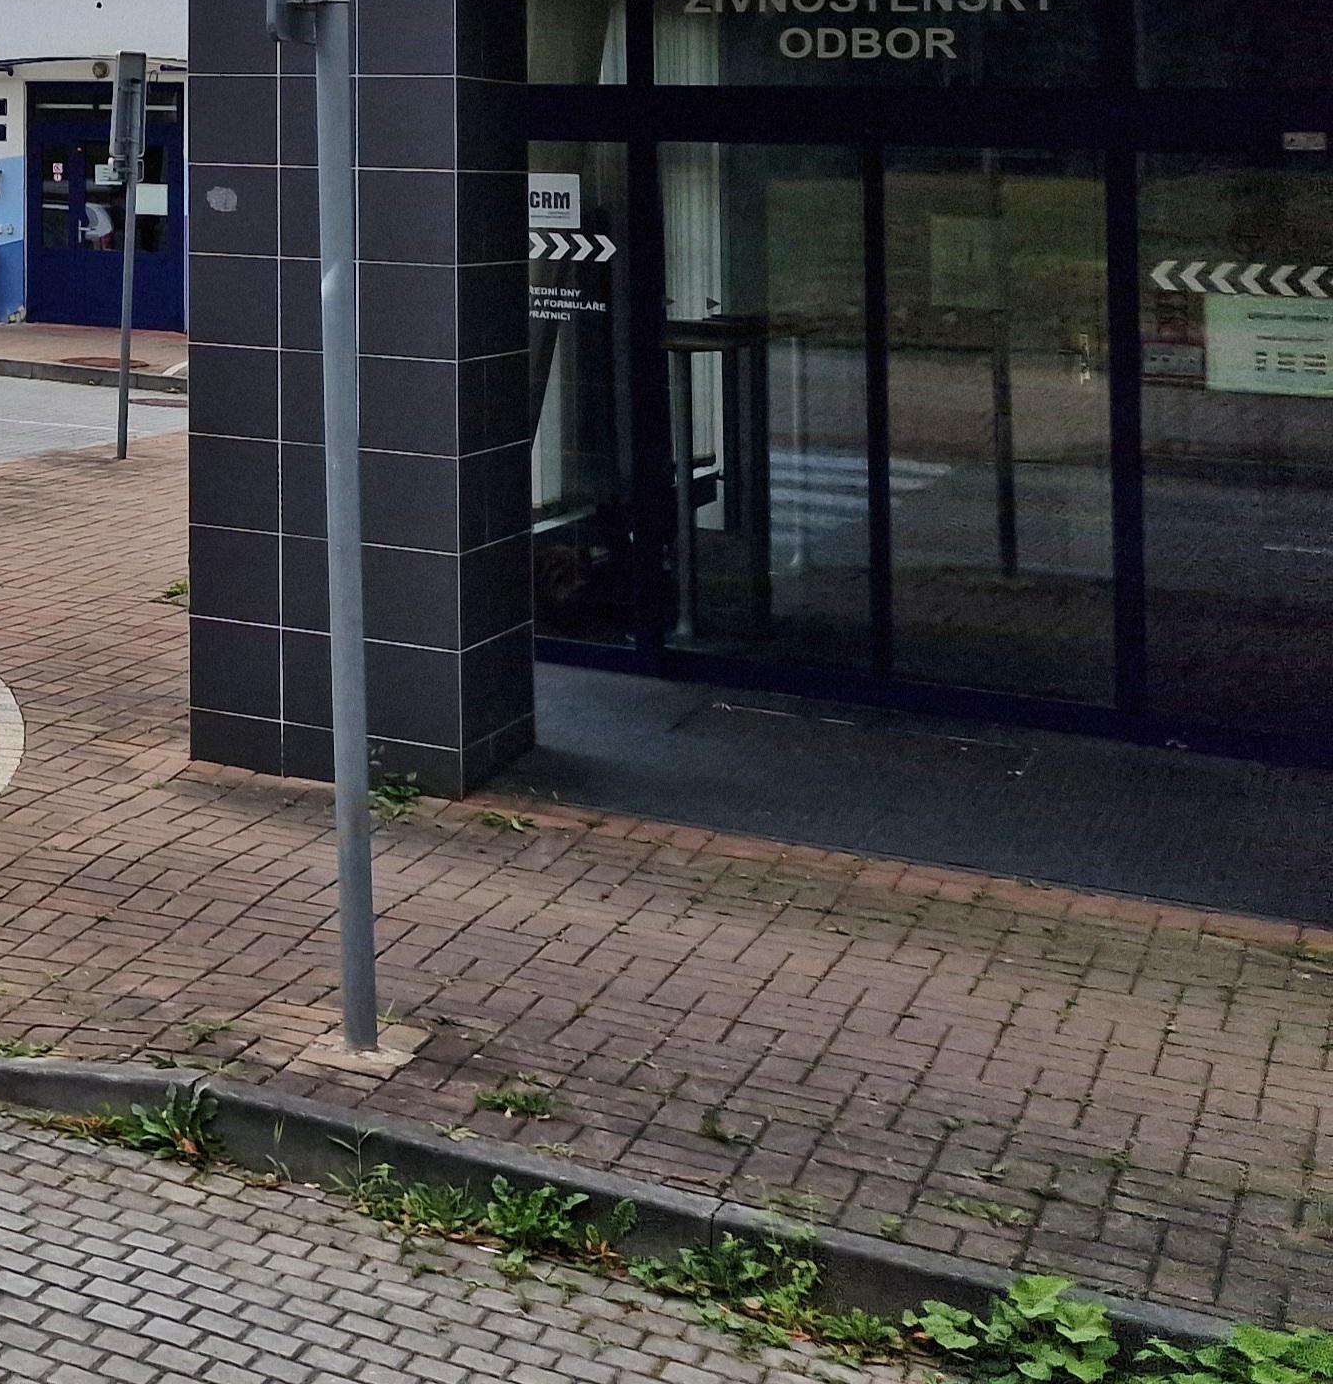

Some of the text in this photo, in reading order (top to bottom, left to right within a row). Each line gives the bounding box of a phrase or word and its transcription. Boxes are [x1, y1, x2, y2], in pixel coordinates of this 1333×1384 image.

[779, 27, 958, 59] ODBOR
[529, 191, 571, 210] CRM
[560, 287, 581, 298] DNY
